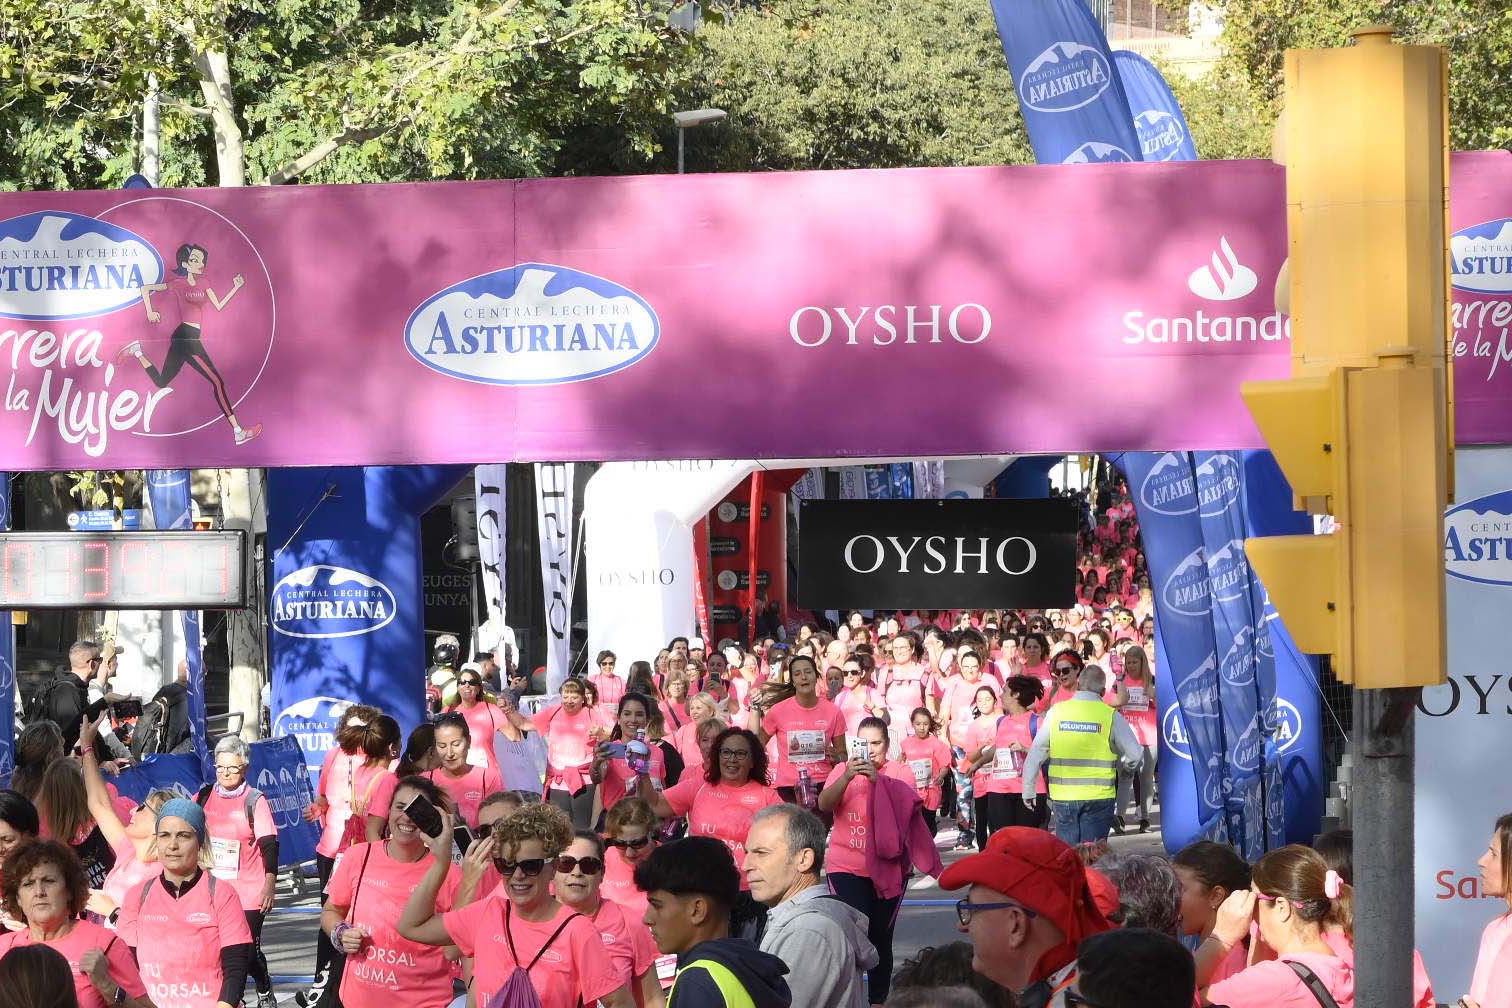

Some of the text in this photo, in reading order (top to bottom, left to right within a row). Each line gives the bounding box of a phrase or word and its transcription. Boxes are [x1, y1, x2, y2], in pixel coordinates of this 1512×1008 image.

[67, 248, 139, 259] LECHERA
[464, 305, 631, 319] CENTRAL LECHERA
[424, 311, 640, 355] ASTURIANA
[789, 303, 992, 347] OYSHO
[1122, 311, 1291, 344] Santand
[5, 372, 30, 411] la
[25, 363, 174, 457] Mujer
[844, 535, 1037, 575] OYSHO
[287, 588, 382, 600] CENTRAL LECHERA
[274, 594, 387, 623] ASTURIANA
[1059, 721, 1097, 731] VOLUNTARIS
[701, 823, 716, 833] TU
[366, 945, 417, 967] ORSAL
[144, 963, 161, 977] TU
[355, 963, 398, 985] SUMA
